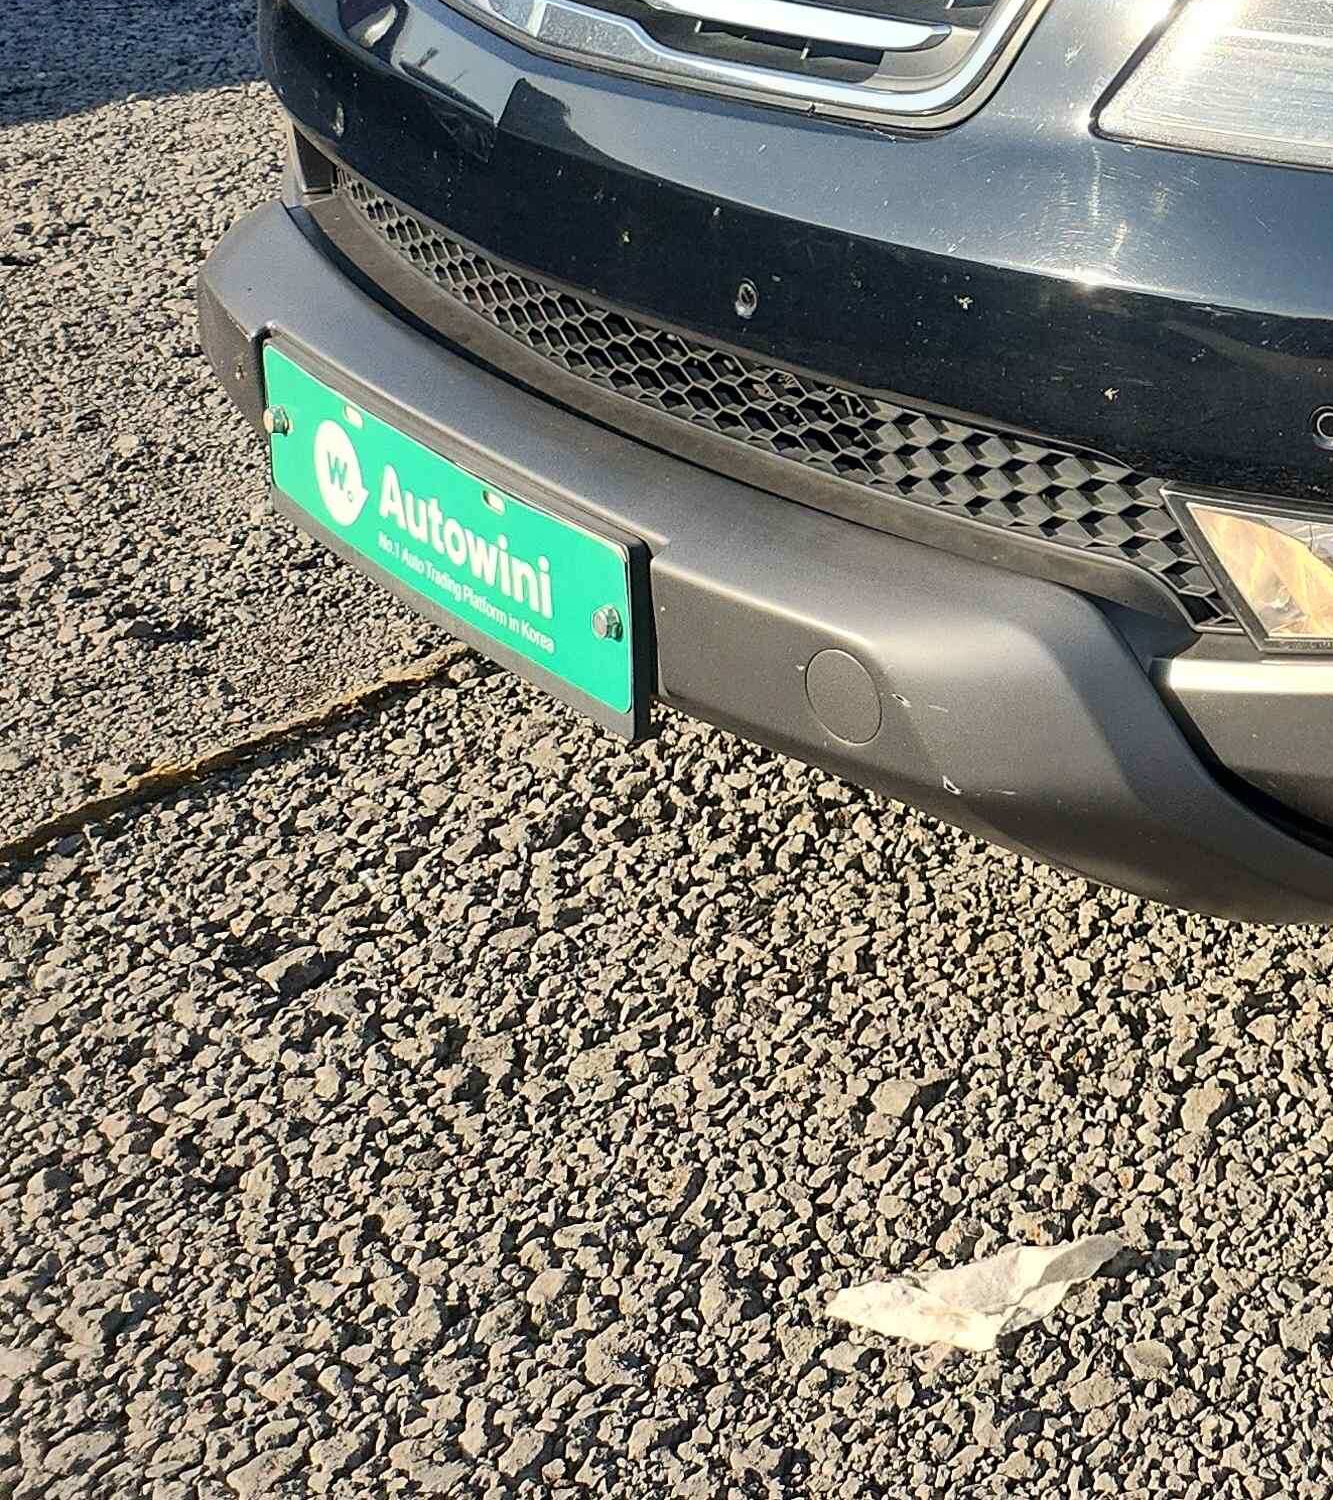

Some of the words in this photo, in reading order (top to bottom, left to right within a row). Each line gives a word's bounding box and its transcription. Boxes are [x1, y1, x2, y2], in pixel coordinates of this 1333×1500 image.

[378, 463, 553, 620] Autowini
[378, 531, 400, 559] No.1
[401, 548, 426, 574] Auto
[425, 560, 462, 603] Trading
[463, 585, 508, 627] Platform
[519, 621, 556, 655] Korea
